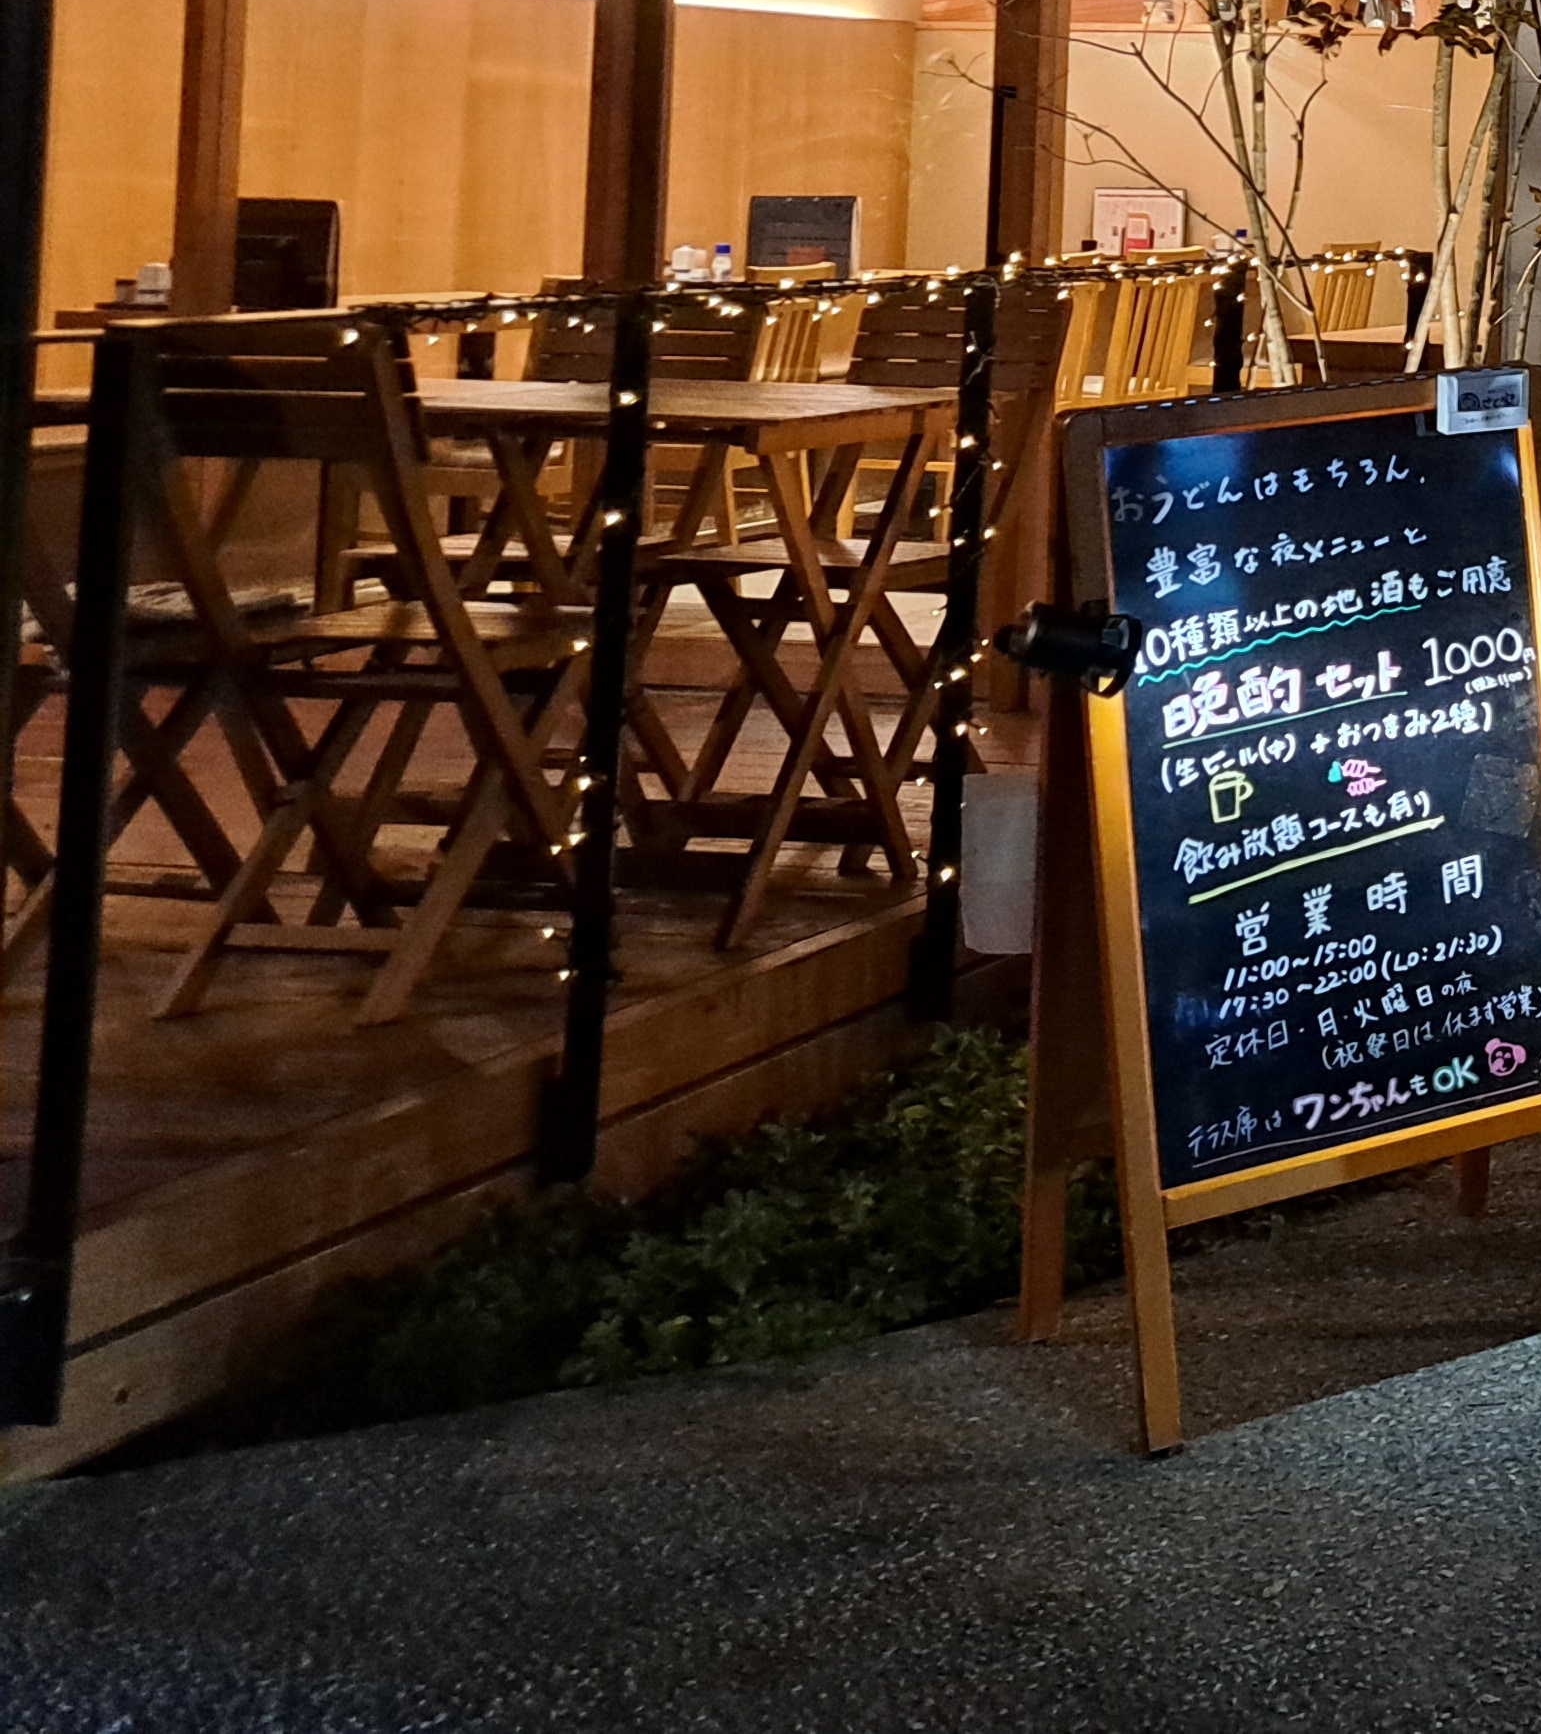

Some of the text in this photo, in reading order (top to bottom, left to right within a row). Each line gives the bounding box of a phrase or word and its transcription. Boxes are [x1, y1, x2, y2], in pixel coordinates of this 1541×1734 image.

[1161, 627, 1537, 740] 晩酌セット 1000円
[1173, 790, 1432, 884] 飲み放題コースも有り
[1234, 854, 1484, 957] 営業時間
